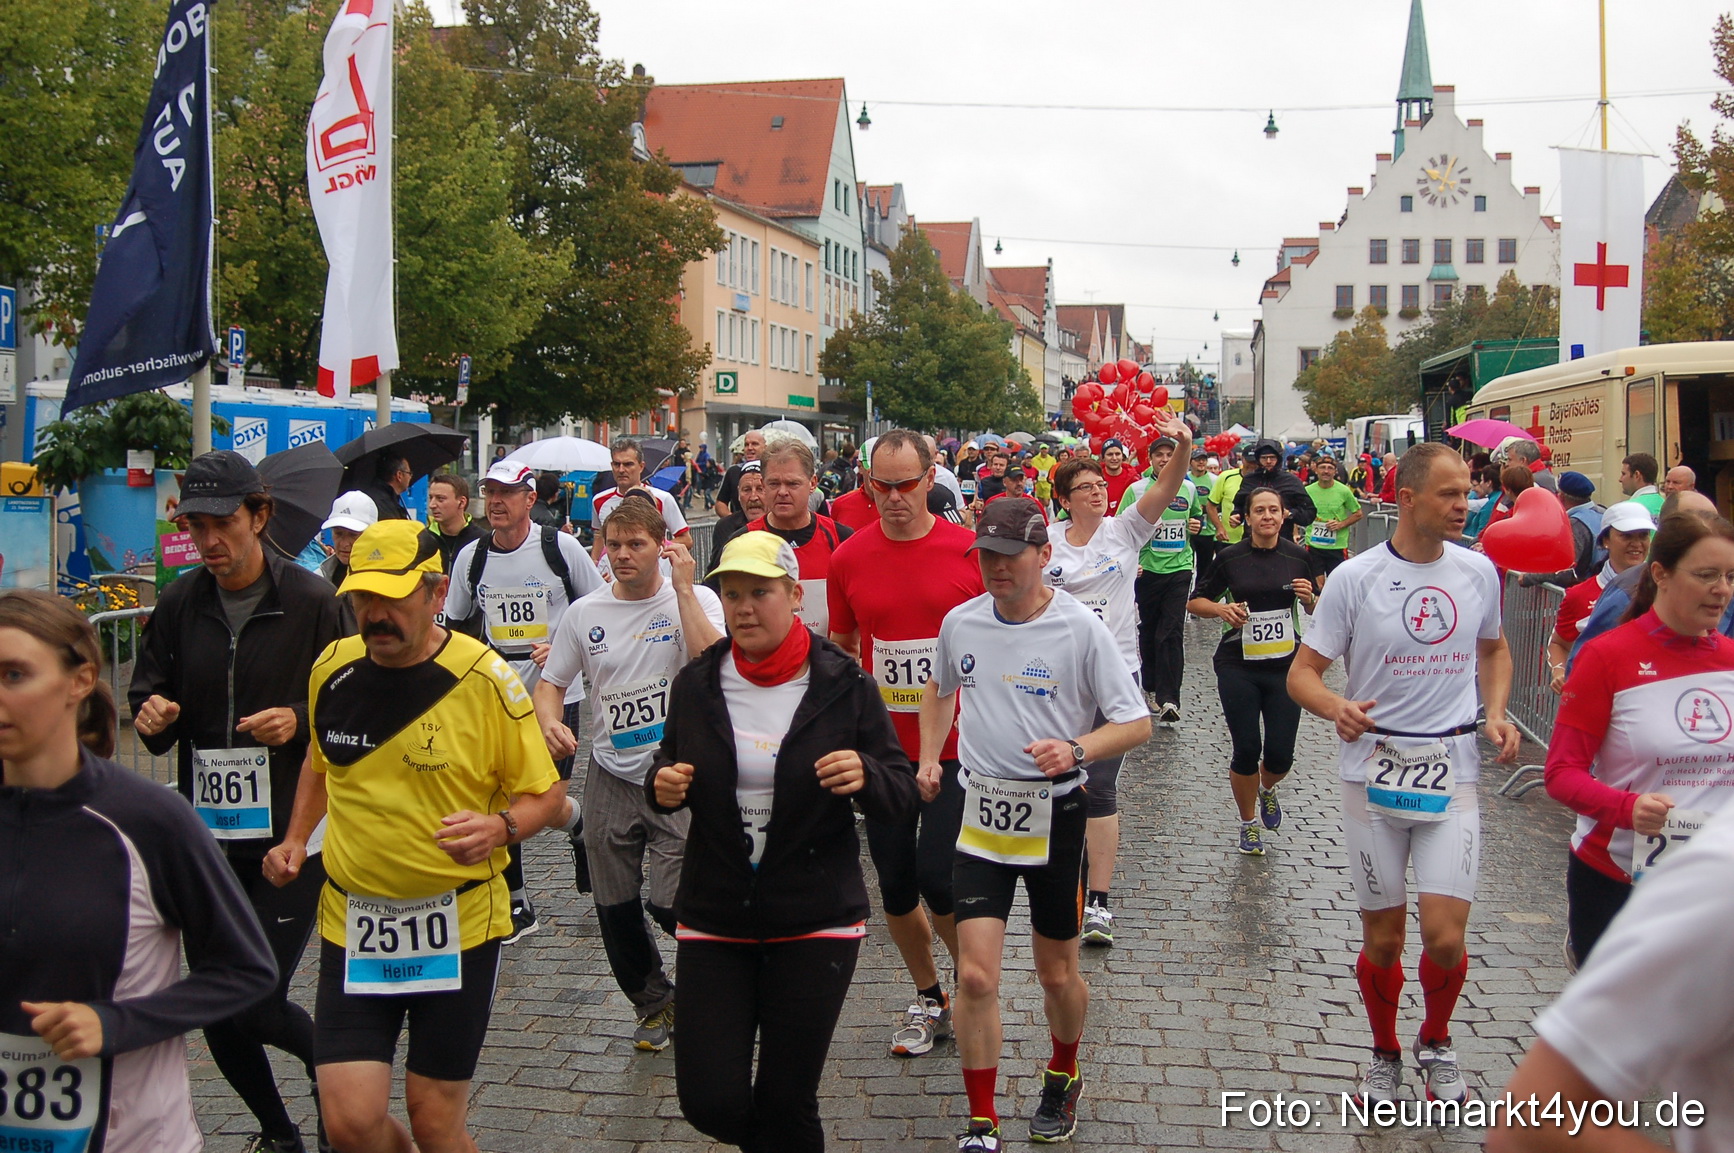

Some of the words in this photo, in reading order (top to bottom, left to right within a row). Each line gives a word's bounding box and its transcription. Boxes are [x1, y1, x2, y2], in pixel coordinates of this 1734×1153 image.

[1, 296, 11, 340] P
[233, 334, 242, 360] P
[461, 360, 469, 381] P
[718, 374, 735, 391] D
[1550, 396, 1599, 423] Bayerisches
[1549, 426, 1572, 444] Rotes
[1155, 527, 1184, 540] 2154
[165, 545, 187, 554] BEIDE
[497, 601, 535, 623] 188
[1260, 614, 1284, 622] Neumarkt
[509, 629, 524, 637] Udo
[1252, 621, 1285, 642] 529
[589, 643, 609, 652] PARTL
[874, 646, 894, 655] PARTL
[895, 647, 932, 655] Neumarkt
[1385, 654, 1425, 664] LAUFEN
[1430, 655, 1448, 663] MIT
[330, 667, 354, 691] STANNO
[884, 657, 932, 685] 313
[1002, 674, 1015, 683] 14.
[601, 693, 620, 702] PARTL
[621, 683, 657, 698] Neumarkt
[609, 690, 667, 731] 2257
[421, 723, 442, 732] TSV
[634, 729, 657, 743] Rudi
[326, 730, 358, 745] Heinz
[362, 733, 376, 747] L.
[211, 757, 252, 767] Neumarkt
[402, 754, 449, 772] Burgthann
[1402, 753, 1442, 764] Neumarkt
[1657, 756, 1698, 766] LAUFEN
[1702, 755, 1722, 763] MIT
[1375, 758, 1449, 791] 2722
[1677, 767, 1696, 775] Heck
[198, 770, 259, 805] 2861
[968, 779, 990, 794] PARTL
[992, 787, 1036, 799] Neumarkt
[1396, 795, 1421, 809] Knut
[979, 796, 1032, 832] 532
[1461, 828, 1473, 876] 2XU
[1360, 850, 1382, 895] 2XU
[349, 899, 381, 913] PARTL
[384, 900, 437, 914] Neumarkt
[357, 911, 448, 953] 2510
[383, 964, 423, 978] Heinz
